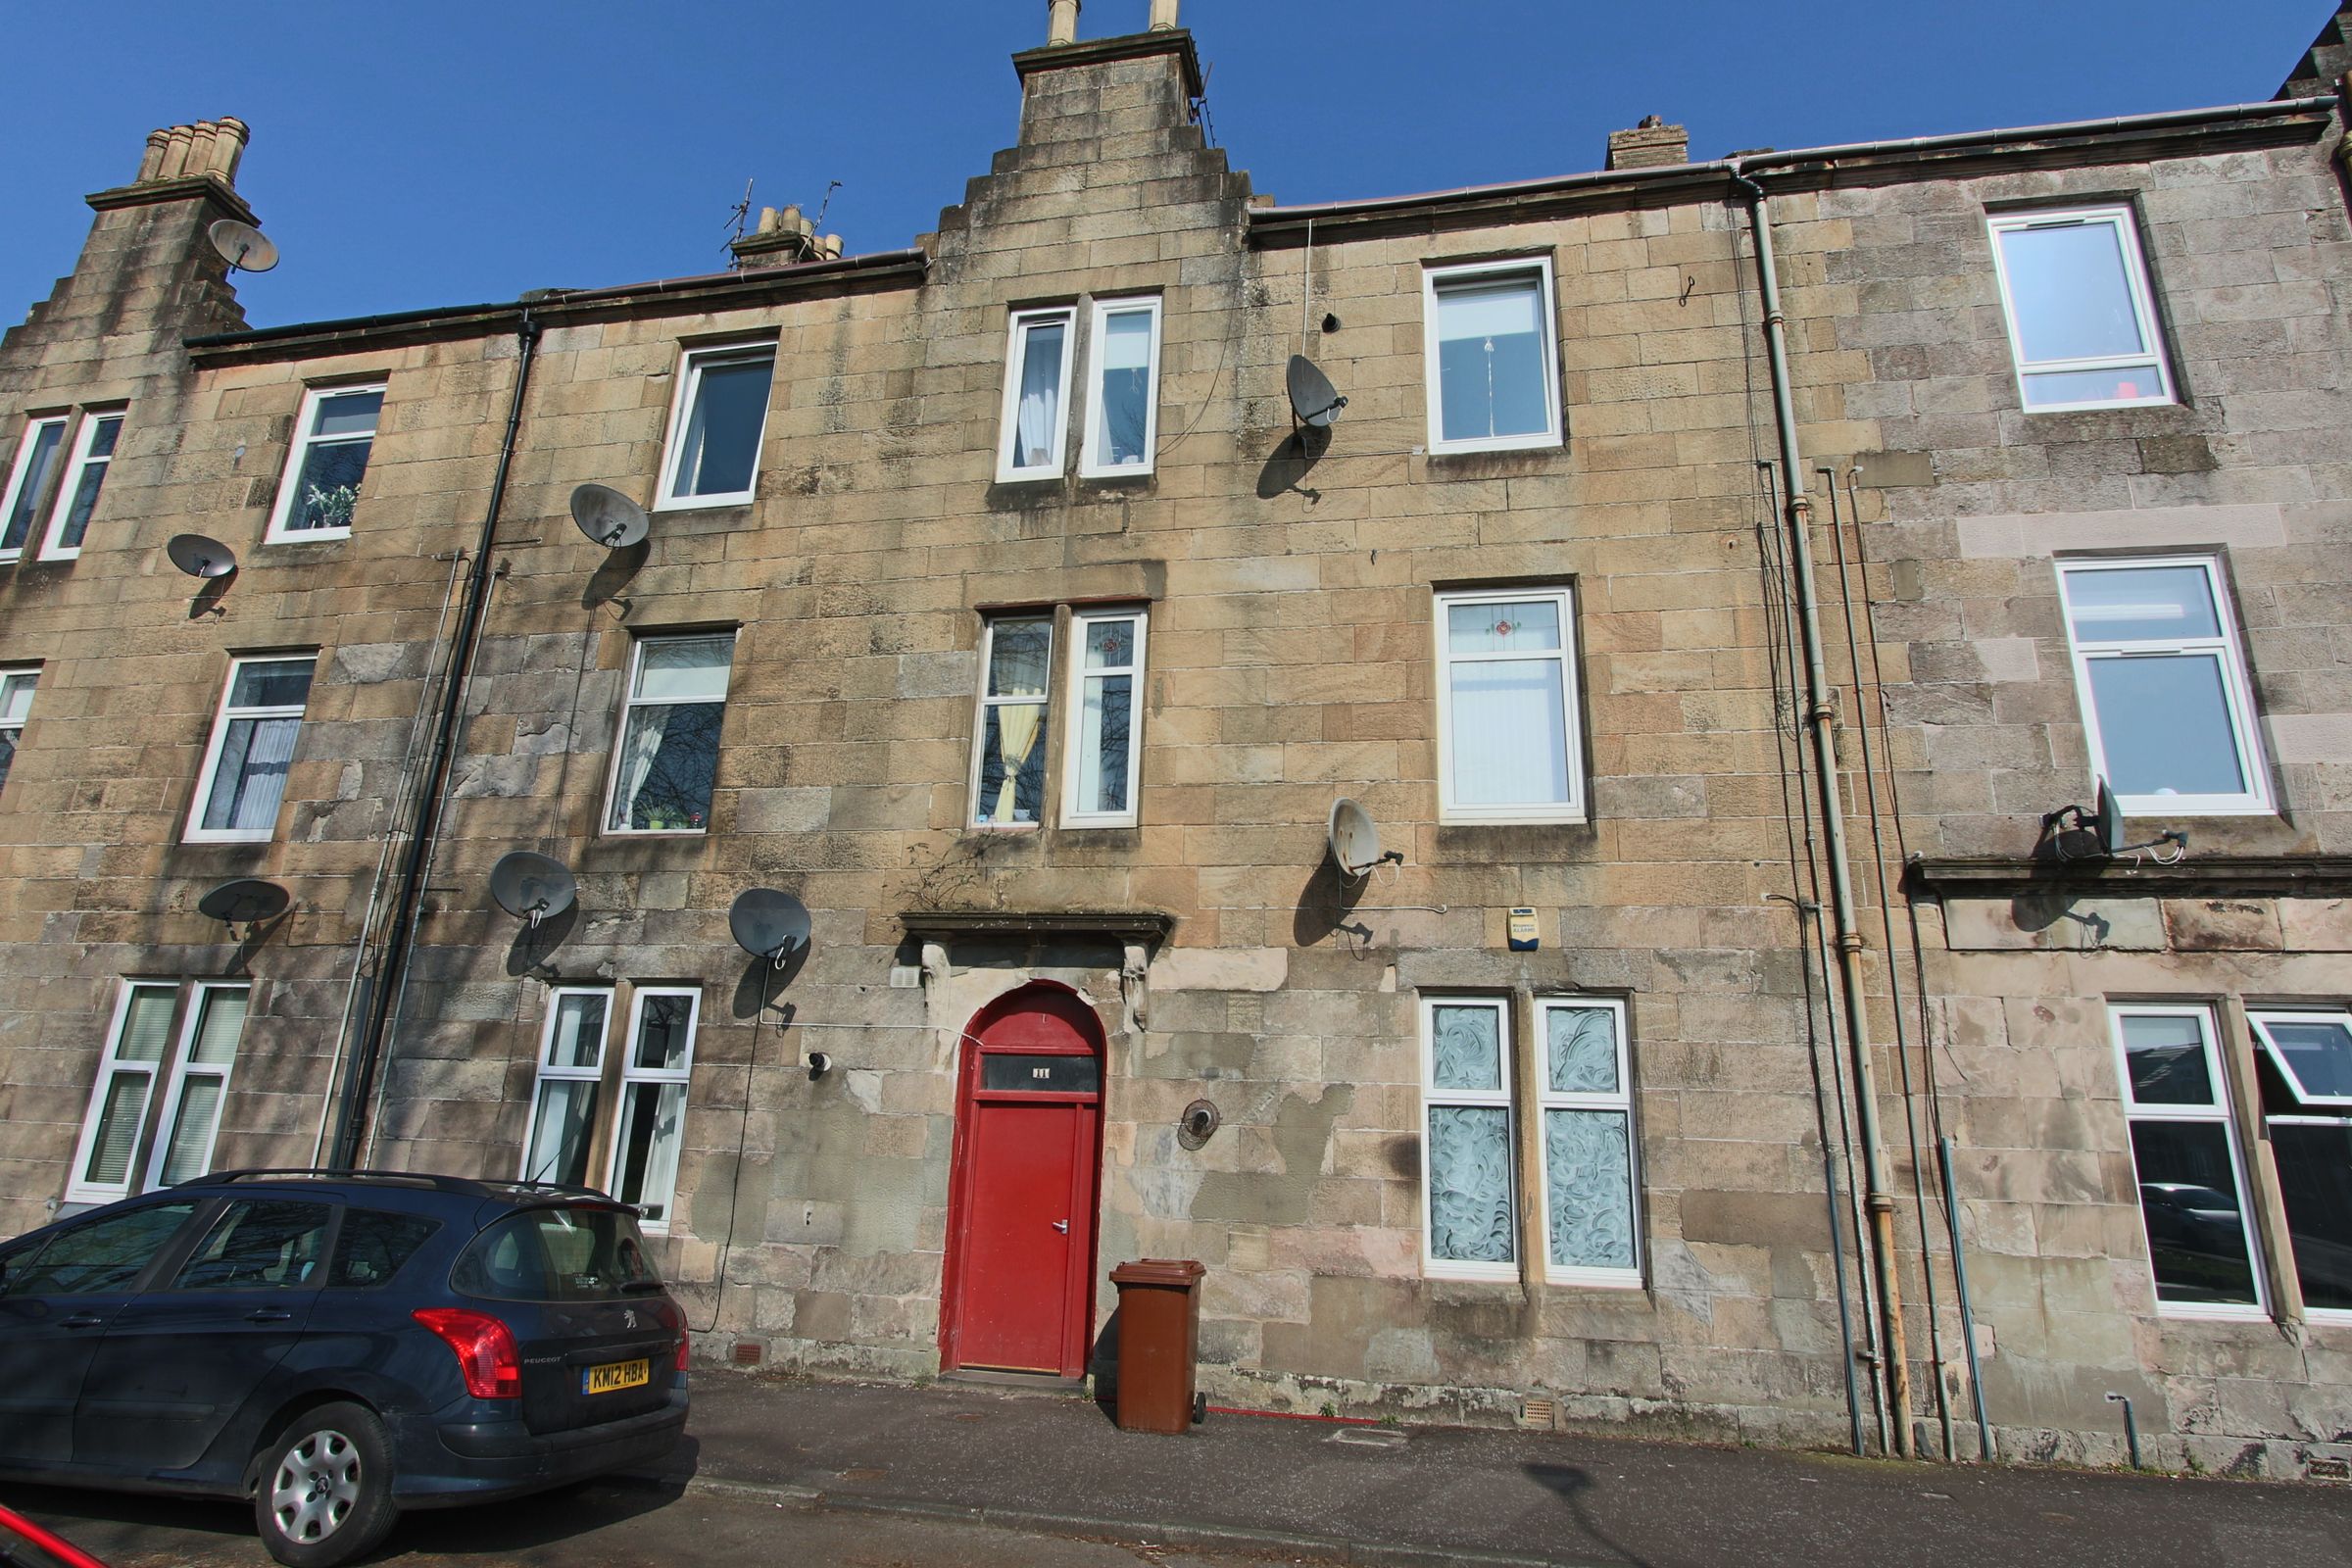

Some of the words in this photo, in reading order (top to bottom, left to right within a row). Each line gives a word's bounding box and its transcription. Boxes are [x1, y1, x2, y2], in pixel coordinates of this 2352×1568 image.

[523, 1355, 563, 1365] PEUGEOT
[593, 1364, 622, 1389] KM12
[623, 1362, 644, 1384] HBA
